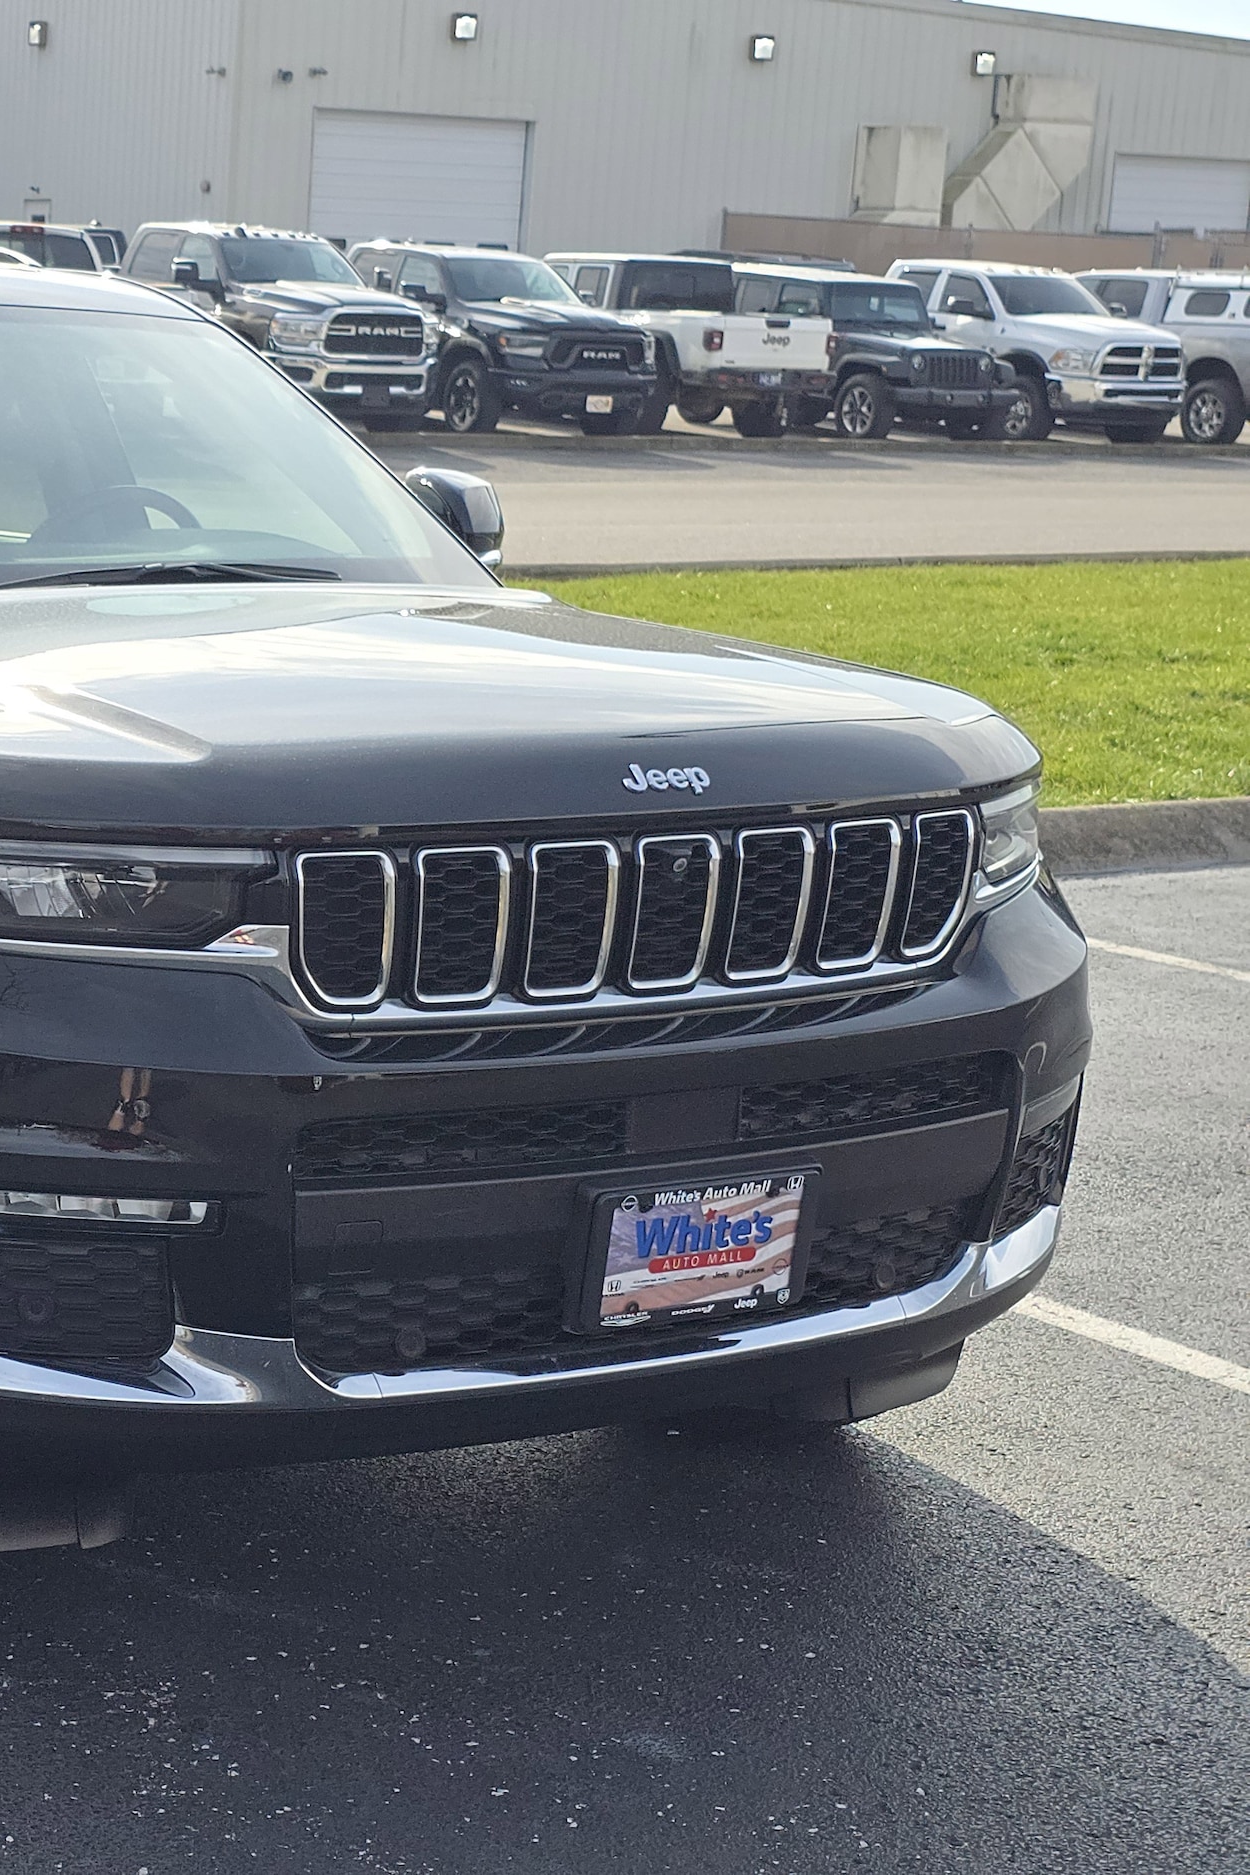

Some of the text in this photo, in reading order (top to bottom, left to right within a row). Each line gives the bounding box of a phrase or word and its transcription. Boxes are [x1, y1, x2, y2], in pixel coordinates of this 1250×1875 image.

[358, 326, 399, 336] RAM
[762, 332, 790, 347] Jeep
[583, 350, 621, 359] RAM
[622, 763, 711, 795] Jeep
[654, 1179, 772, 1206] White's Auto Mall
[635, 1210, 773, 1258] White's
[663, 1250, 742, 1270] AUTO MALL
[734, 1298, 758, 1310] Jeep
